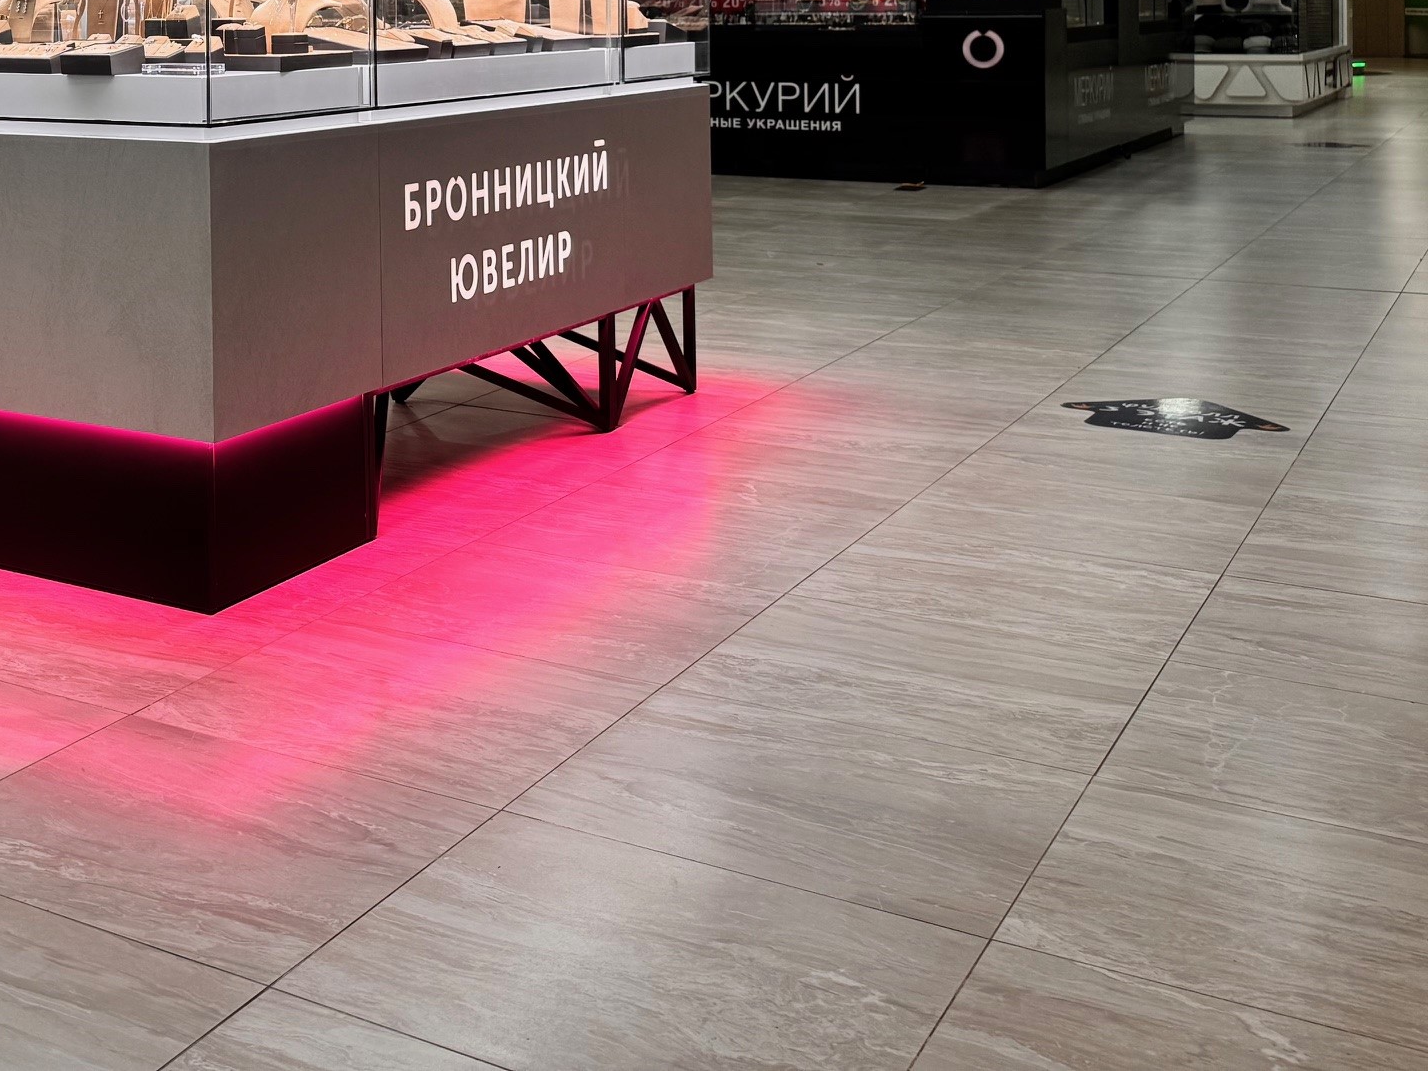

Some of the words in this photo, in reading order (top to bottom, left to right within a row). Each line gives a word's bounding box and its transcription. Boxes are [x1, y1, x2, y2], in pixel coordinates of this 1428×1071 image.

[702, 74, 860, 115] РКУРИЙ
[710, 117, 741, 129] НЫЕ
[747, 118, 842, 132] УКРАШЕНИЯ
[404, 139, 608, 231] БРОННИЦКИЙ
[450, 230, 572, 303] ЮВЕЛИР
